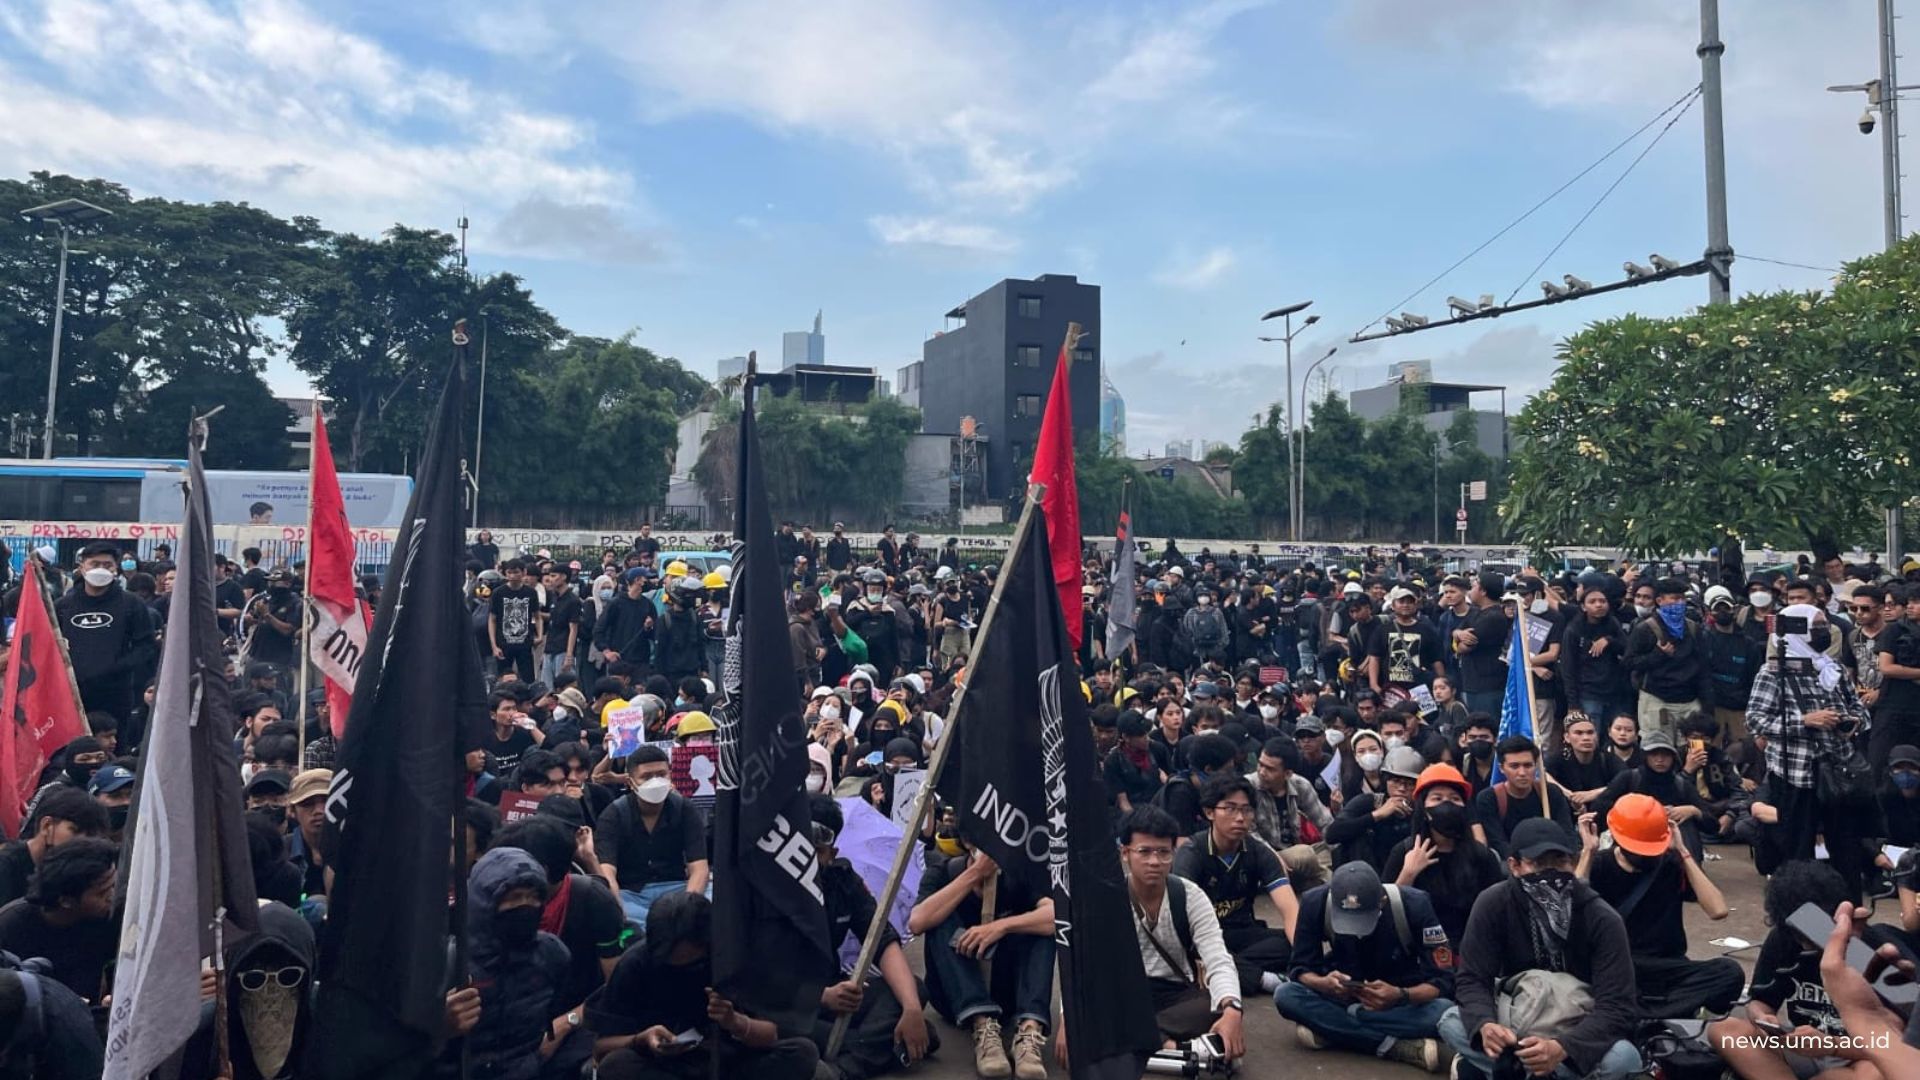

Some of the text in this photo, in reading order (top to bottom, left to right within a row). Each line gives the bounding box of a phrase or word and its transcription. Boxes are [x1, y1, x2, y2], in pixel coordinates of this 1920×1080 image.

[511, 532, 560, 544] TEDDY
[757, 813, 824, 906] GEL
[972, 782, 1050, 862] INDO
